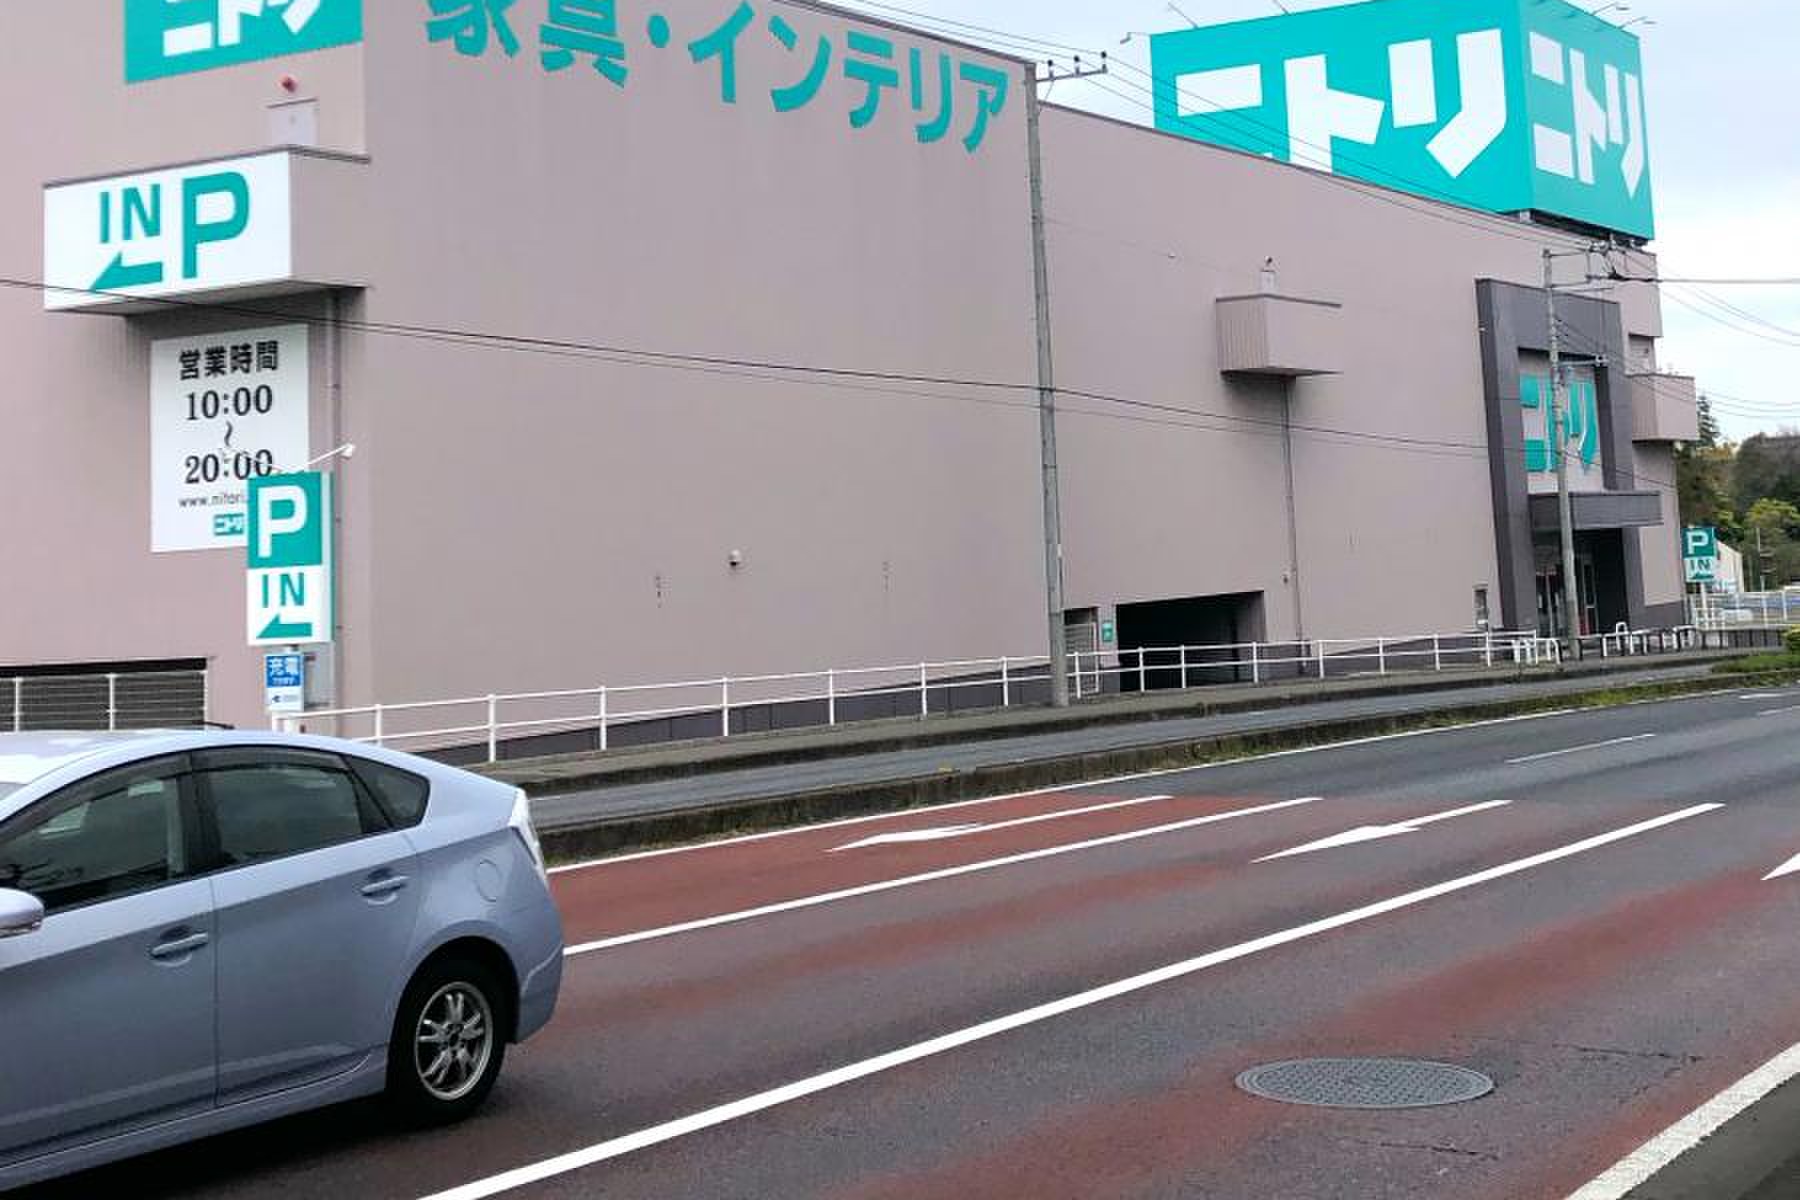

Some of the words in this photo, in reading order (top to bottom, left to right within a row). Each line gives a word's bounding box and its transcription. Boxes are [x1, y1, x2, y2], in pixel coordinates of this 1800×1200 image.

[1529, 31, 1645, 200] ニトリ
[99, 183, 161, 243] IN
[182, 171, 250, 279] P
[178, 340, 280, 380] 営業時間
[186, 384, 273, 421] 10:00
[185, 449, 273, 484] 20:00
[257, 485, 308, 558] P
[1686, 530, 1709, 554] P
[1689, 558, 1710, 570] IN
[262, 572, 304, 608] IN
